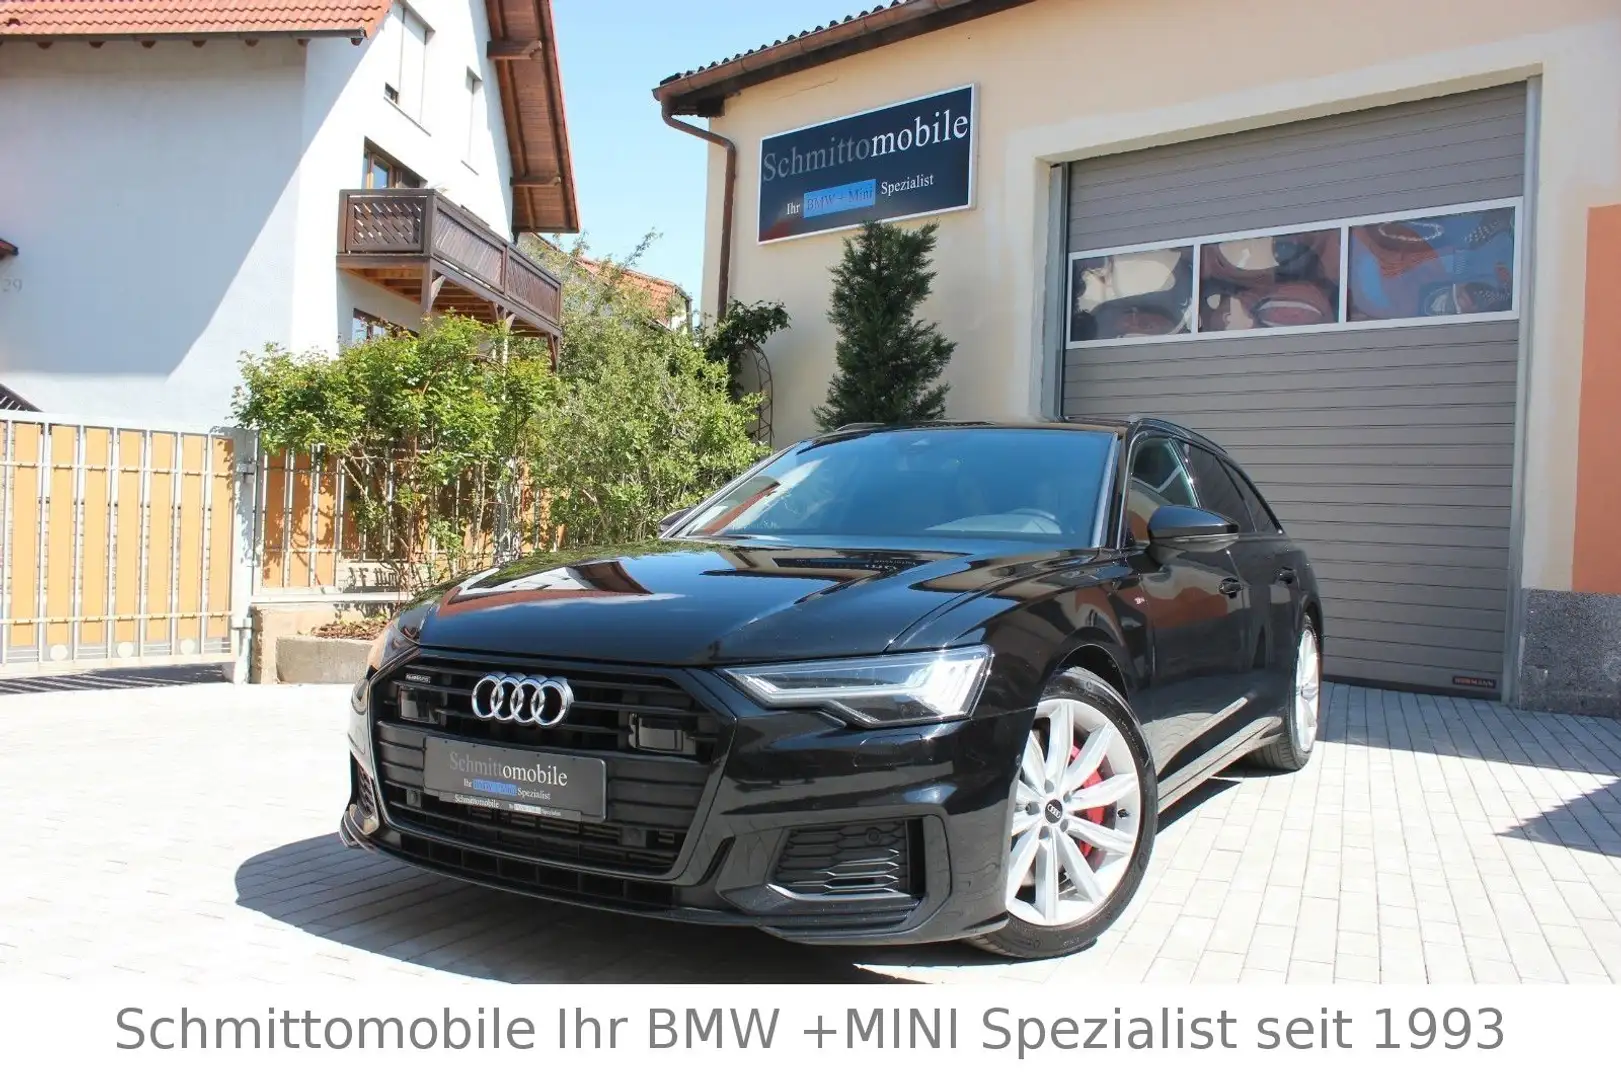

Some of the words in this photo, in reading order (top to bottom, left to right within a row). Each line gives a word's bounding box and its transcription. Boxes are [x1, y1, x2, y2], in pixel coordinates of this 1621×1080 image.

[763, 109, 968, 181] Schmittomobile
[787, 202, 800, 215] Ihr
[807, 192, 836, 211] BMW
[848, 185, 873, 203] Mini
[881, 173, 934, 196] Spezialist
[450, 752, 568, 787] Schmittomobile
[517, 787, 551, 801] Spezialist
